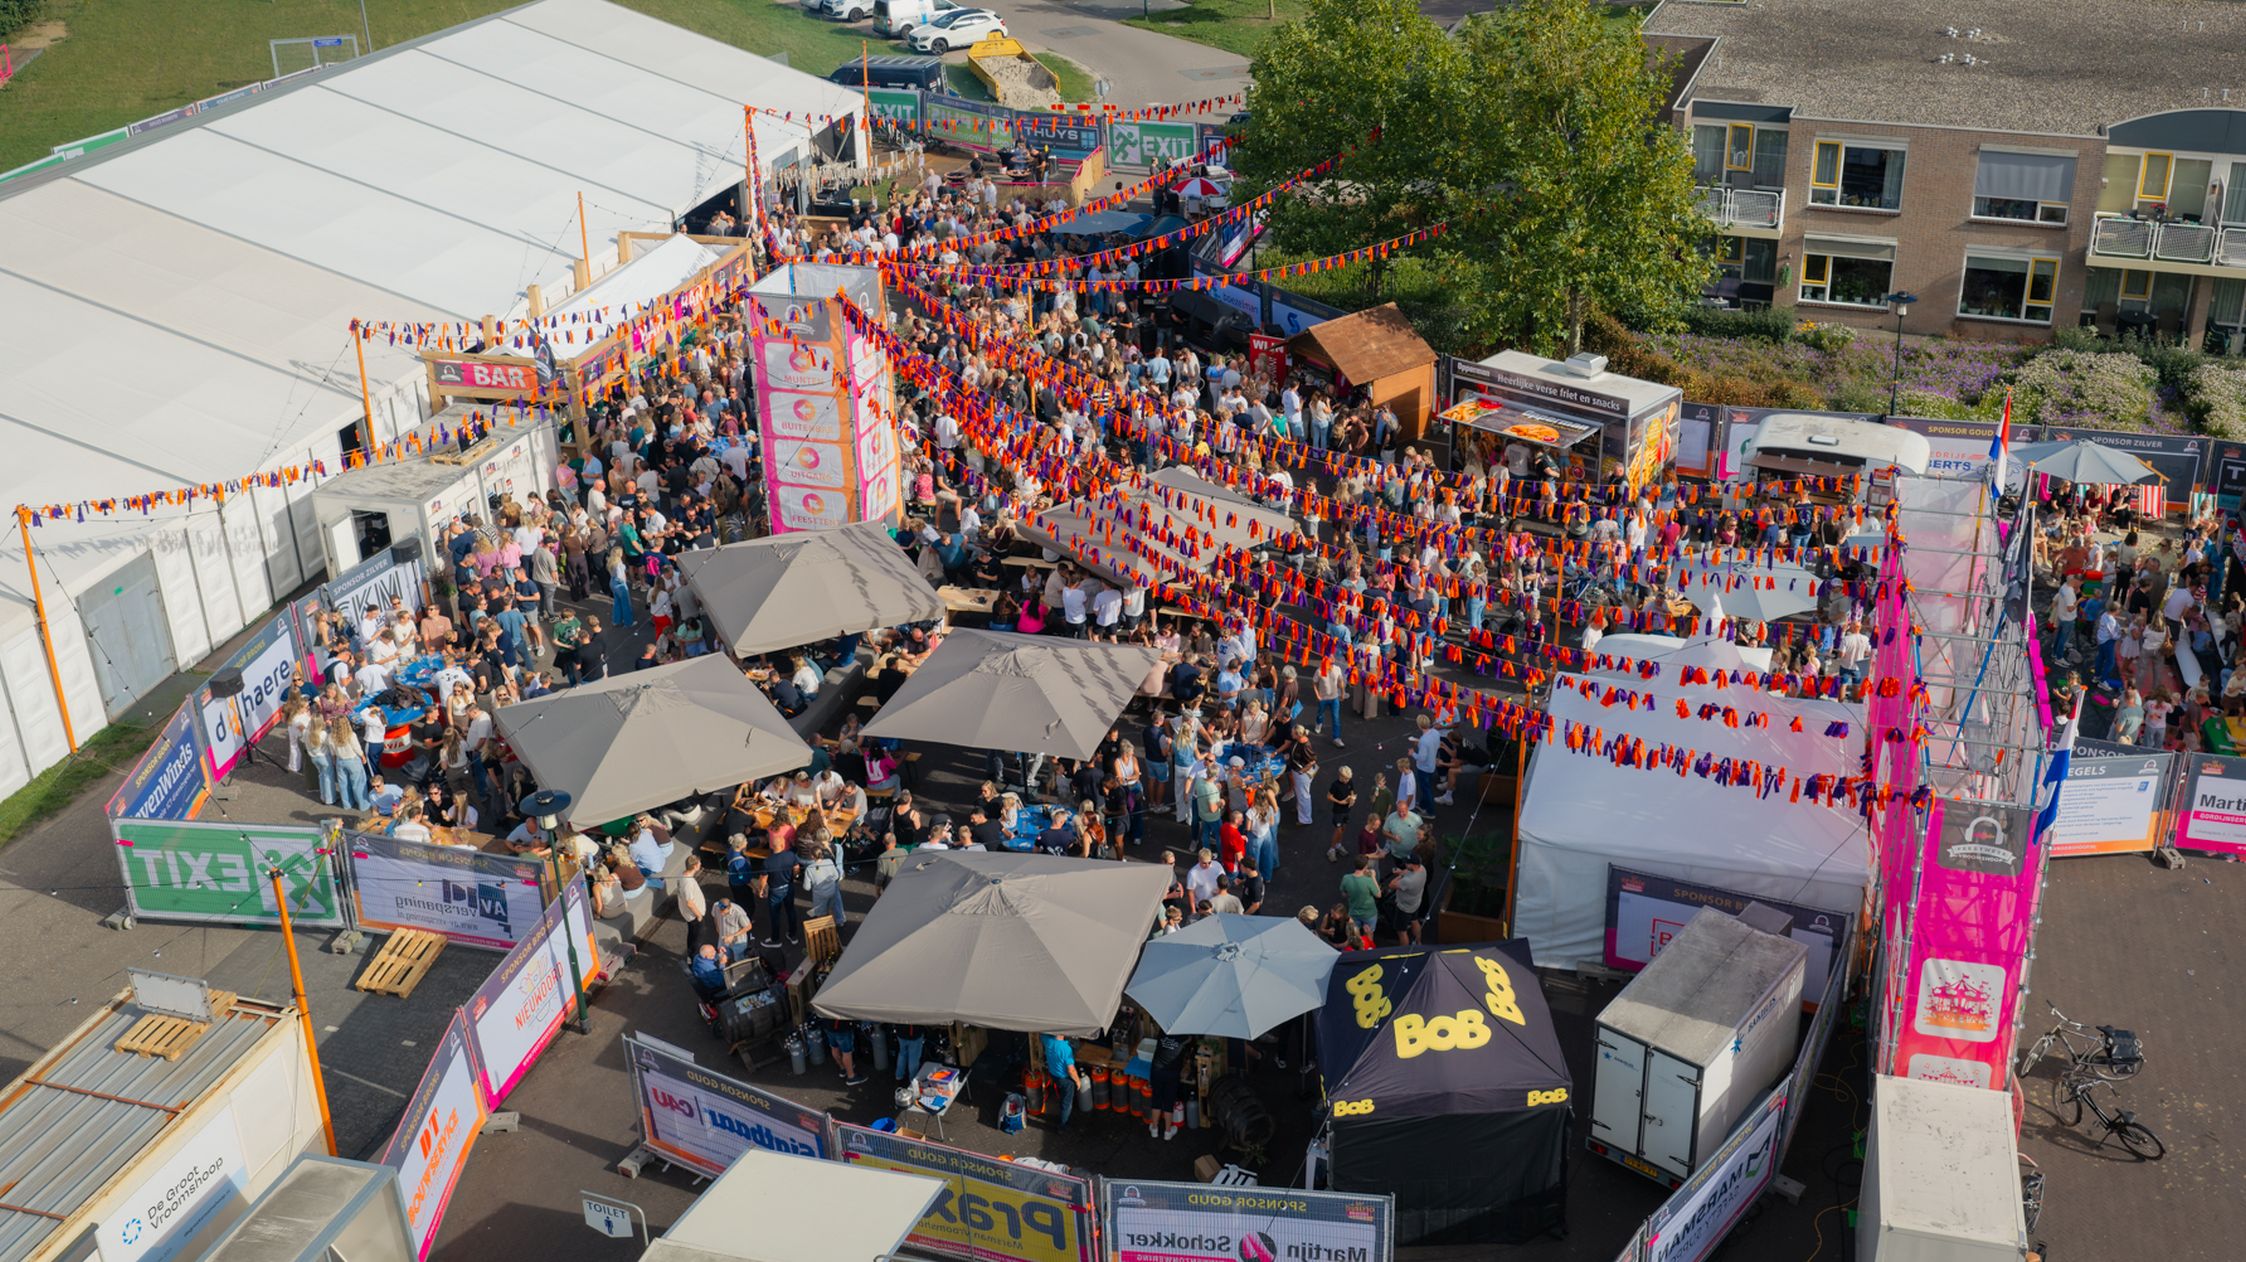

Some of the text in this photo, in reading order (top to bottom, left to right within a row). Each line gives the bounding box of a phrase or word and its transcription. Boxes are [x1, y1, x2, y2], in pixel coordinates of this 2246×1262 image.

[873, 103, 914, 128] EXIT
[1142, 135, 1190, 158] EXIT
[473, 366, 527, 388] BAR
[1497, 374, 1621, 411] Heerlijke verse friet en snacks
[1928, 426, 1994, 437] SPONSOR GOUD
[2092, 436, 2163, 449] SPONSOR ZILVER
[333, 558, 389, 596] SPONSOR ZILVER
[1673, 888, 1732, 909] SPONSOR
[500, 943, 532, 984] SPONSOR
[514, 961, 564, 1031] NIEUWOORD
[1393, 1009, 1492, 1059] BOB
[147, 1165, 200, 1220] De Groot
[150, 1156, 224, 1230] Vroomshoop
[587, 1201, 626, 1220] TOILET
